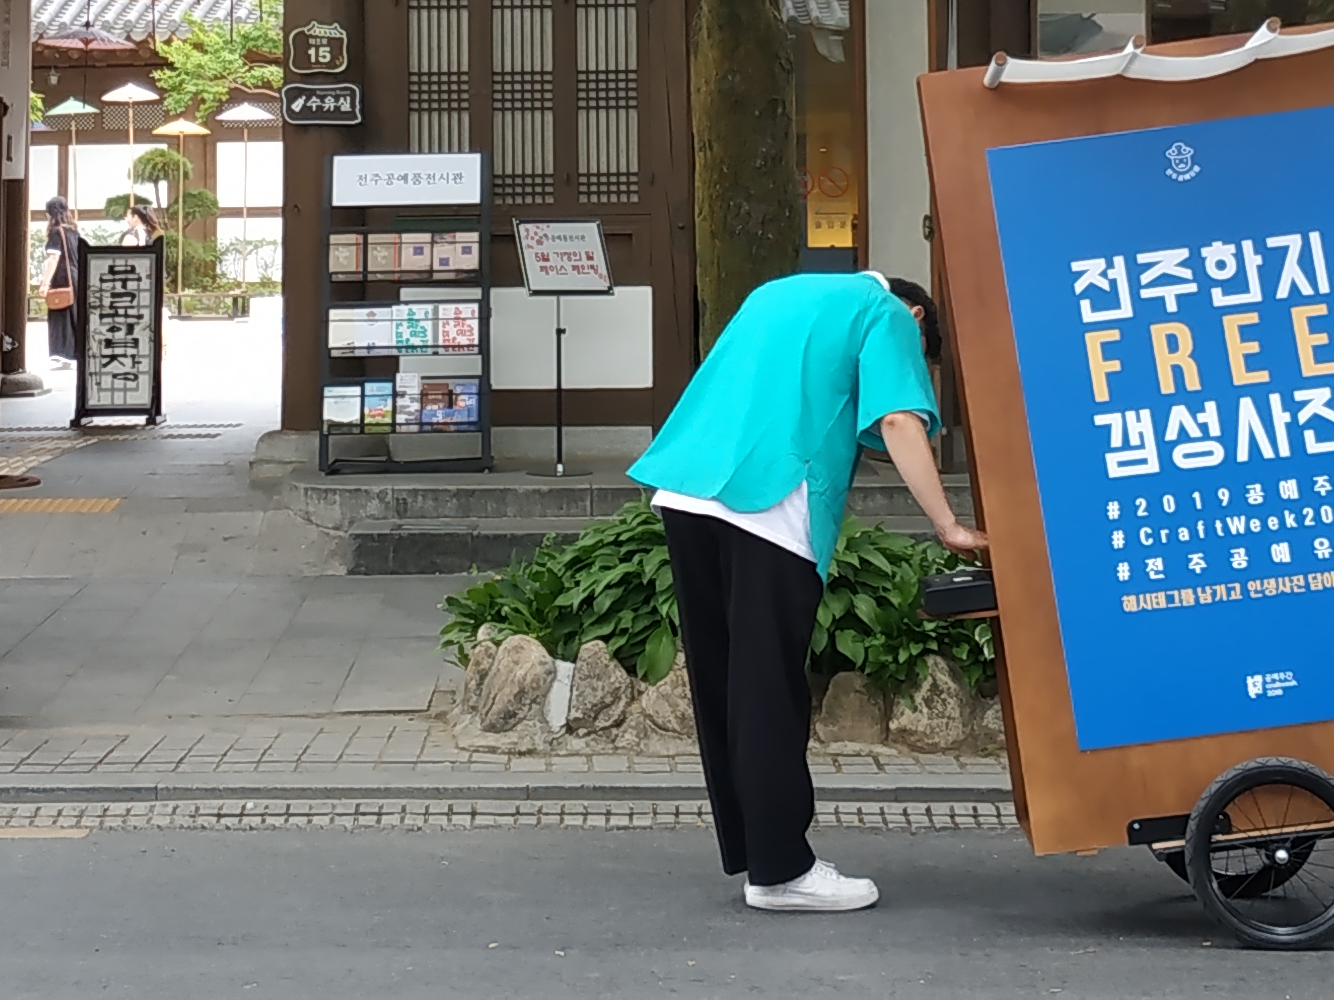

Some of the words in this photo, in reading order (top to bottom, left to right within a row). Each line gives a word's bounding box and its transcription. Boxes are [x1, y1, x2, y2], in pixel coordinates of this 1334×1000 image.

[307, 46, 331, 63] 15
[306, 95, 353, 112] 수유실
[357, 171, 465, 187] 전주공예품전시관
[534, 251, 551, 263] 5월
[552, 250, 583, 263] 가정의
[538, 264, 569, 276] 페이스
[571, 263, 599, 276] 페인팅
[1070, 230, 1331, 324] 전주한지
[99, 264, 145, 382] 무료입장
[1121, 589, 1196, 613] 해시태그를
[1198, 582, 1242, 604] 남기고
[1247, 574, 1306, 599] 인생사진
